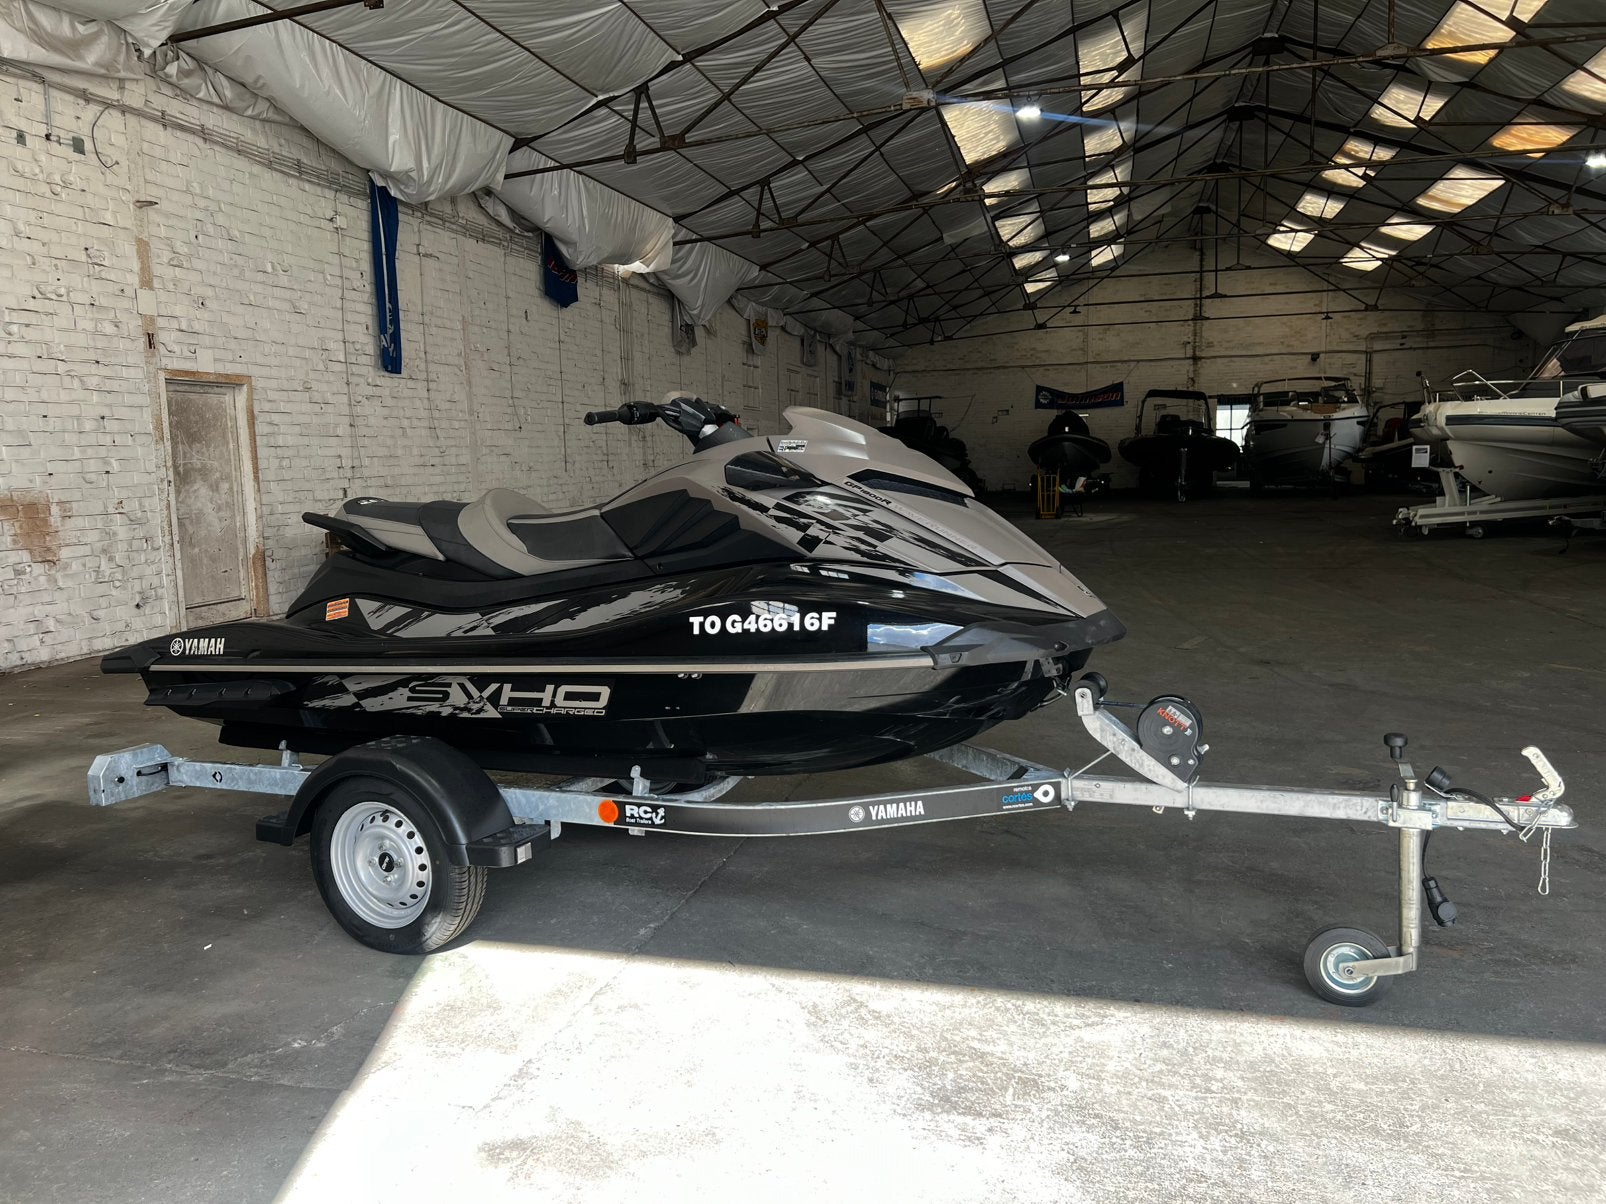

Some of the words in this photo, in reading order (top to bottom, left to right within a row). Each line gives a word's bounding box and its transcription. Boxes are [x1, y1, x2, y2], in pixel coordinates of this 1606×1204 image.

[725, 611, 837, 634] G46616F
[1157, 707, 1187, 731] KNOTT
[625, 804, 652, 819] RC
[869, 800, 925, 820] YAMAHA
